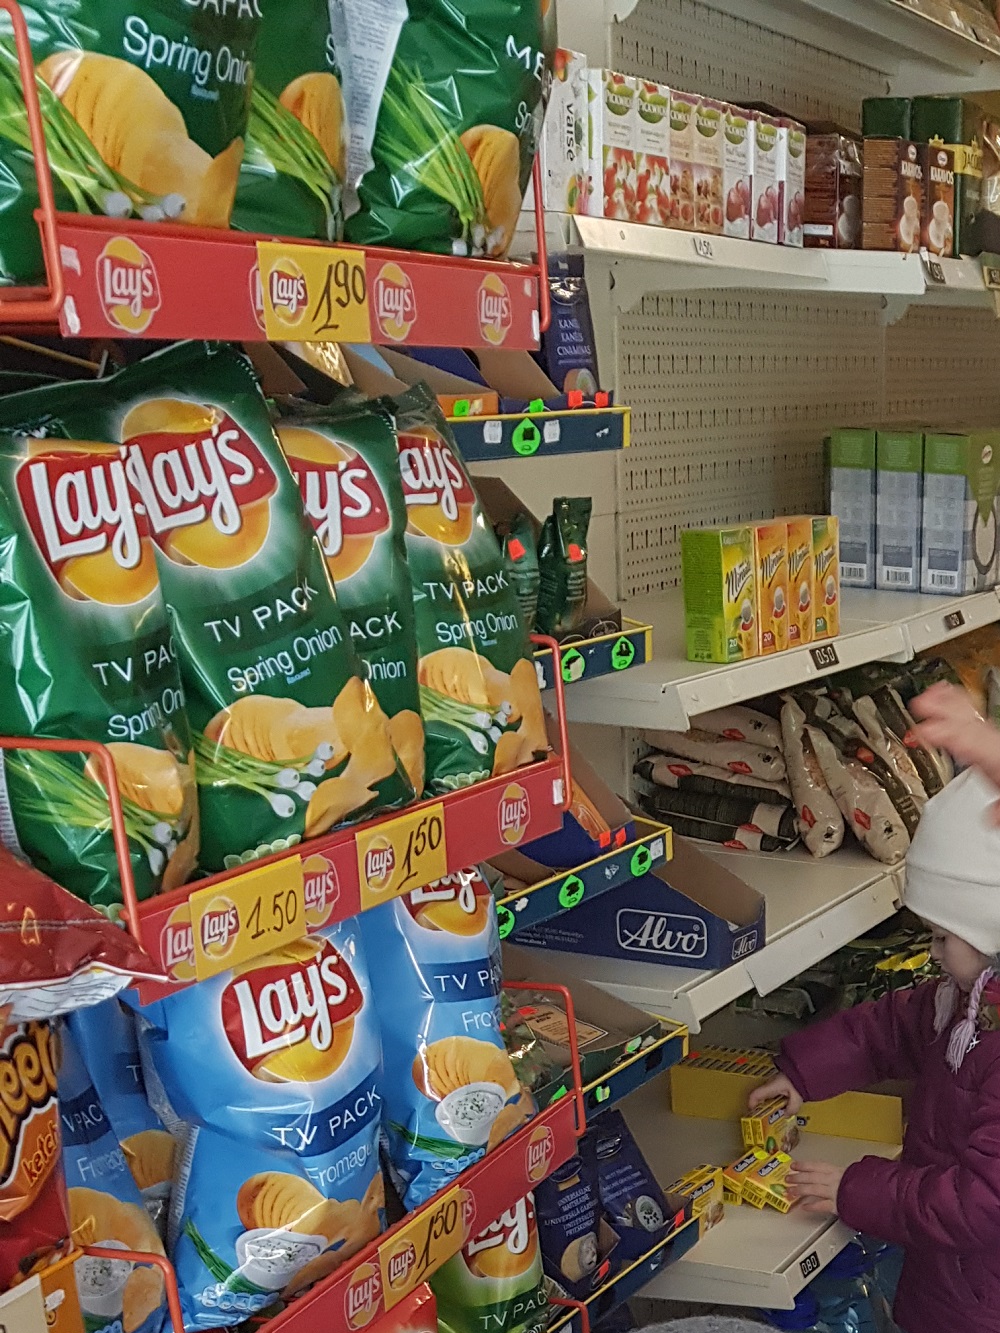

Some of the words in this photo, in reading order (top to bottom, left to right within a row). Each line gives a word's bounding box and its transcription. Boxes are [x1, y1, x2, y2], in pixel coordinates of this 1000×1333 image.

[123, 15, 212, 85] Spring
[104, 256, 155, 318] Lay's
[269, 269, 307, 317] Lay's
[375, 274, 413, 327] Lay's
[479, 288, 510, 333] Lay's
[128, 423, 255, 536] Lay's
[296, 460, 372, 557] y's
[423, 581, 456, 601] TV
[462, 570, 509, 599] PACK
[204, 615, 244, 644] TV
[251, 581, 319, 631] PACK
[349, 612, 403, 641] ACK
[436, 618, 486, 645] Spring
[486, 612, 519, 637] Onion
[92, 656, 134, 687] TV
[227, 647, 295, 694] Spring
[296, 623, 343, 662] Onion
[500, 795, 528, 834] Lay's
[366, 845, 395, 879] Lay's
[201, 905, 240, 947] Lay's
[622, 915, 702, 953] Alvo
[434, 974, 468, 992] TV
[478, 970, 500, 988] PA
[232, 948, 349, 1059] Lay's
[76, 1103, 104, 1128] PAC
[272, 1125, 318, 1151] TV
[328, 1085, 382, 1137] PACK
[527, 1133, 551, 1171] Lay's
[388, 1243, 417, 1282] Lay's
[347, 1270, 382, 1311] Lay's
[479, 1310, 508, 1330] TV
